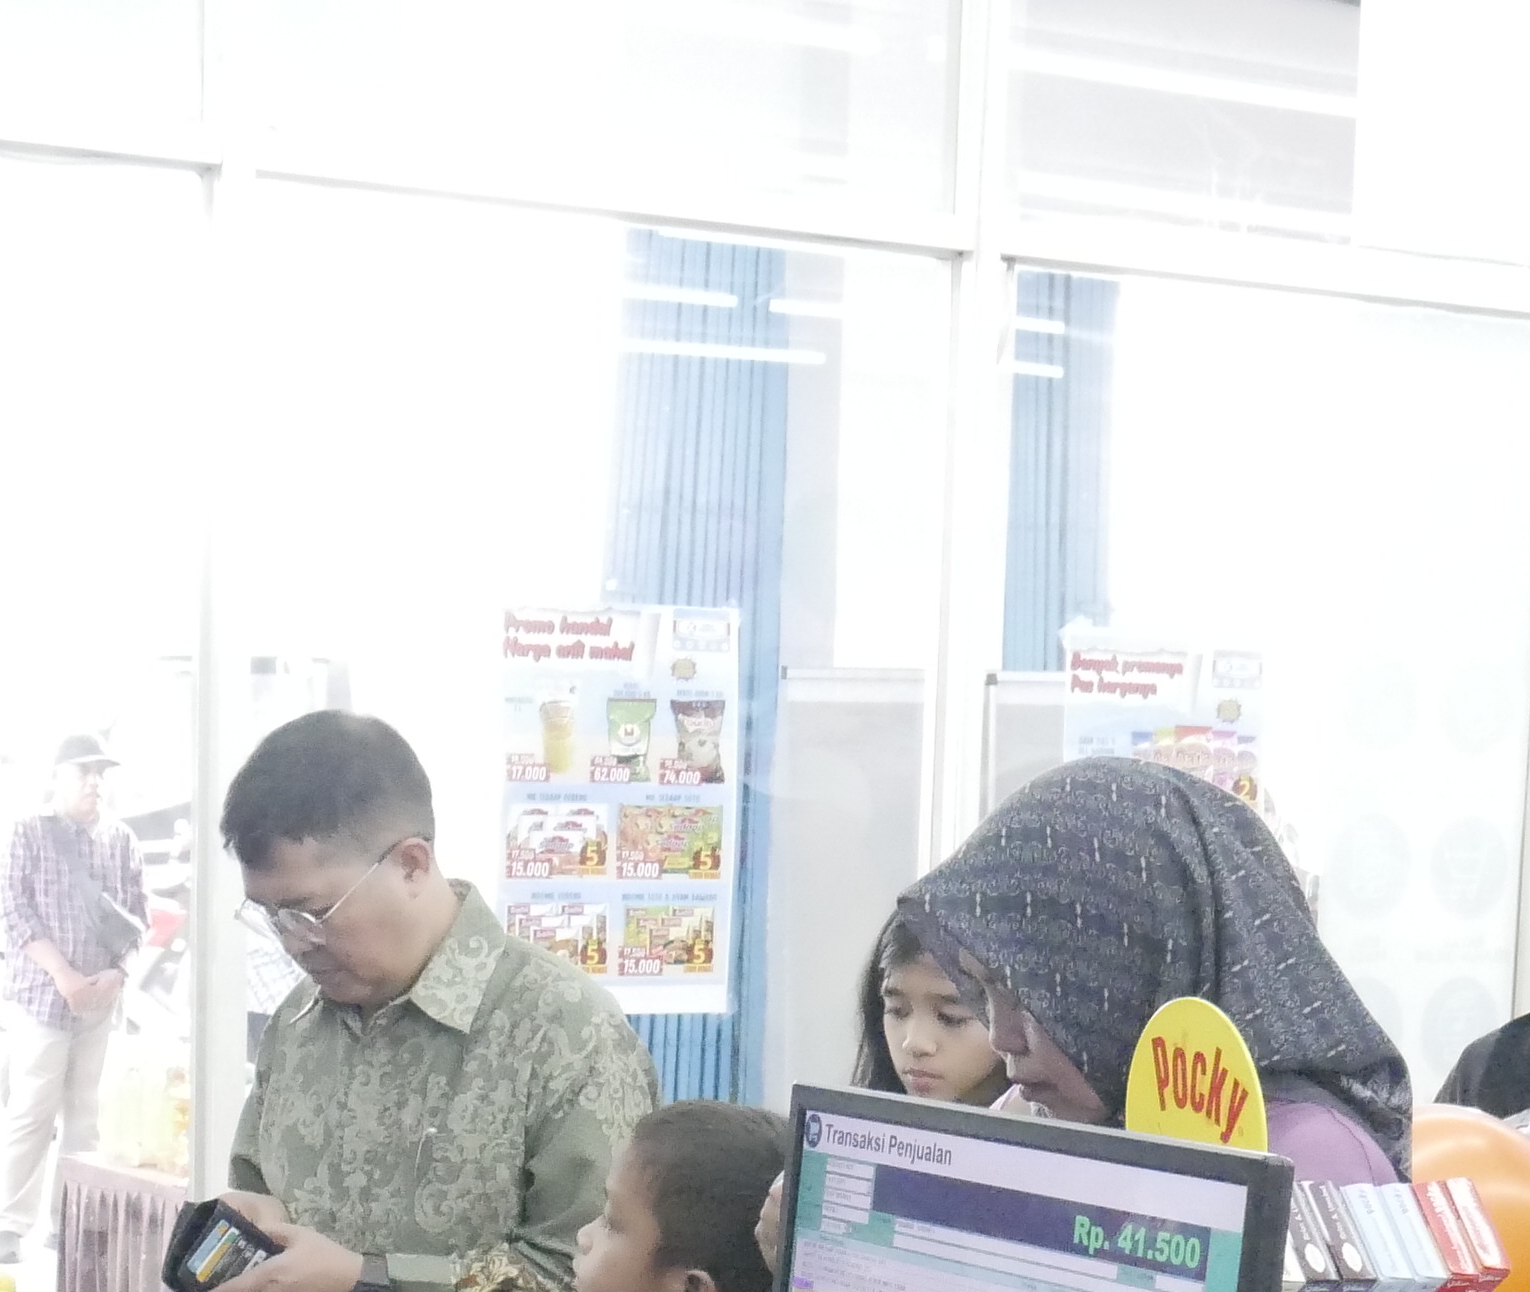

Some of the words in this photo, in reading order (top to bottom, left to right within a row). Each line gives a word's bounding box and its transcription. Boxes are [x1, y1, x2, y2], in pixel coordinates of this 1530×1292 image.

[511, 766, 547, 782] 17.000
[594, 767, 630, 782] 62.000
[663, 771, 701, 784] 74.000
[586, 847, 598, 866] 5
[511, 863, 550, 877] 15.000
[622, 864, 660, 878] 15.000
[587, 943, 598, 962] 5
[694, 944, 706, 962] 5
[623, 960, 660, 974] 15.000
[825, 1123, 886, 1155] Transaksi
[888, 1134, 953, 1168] Penjualan
[1073, 1215, 1110, 1258] Rp.
[1117, 1220, 1202, 1270] 41.500
